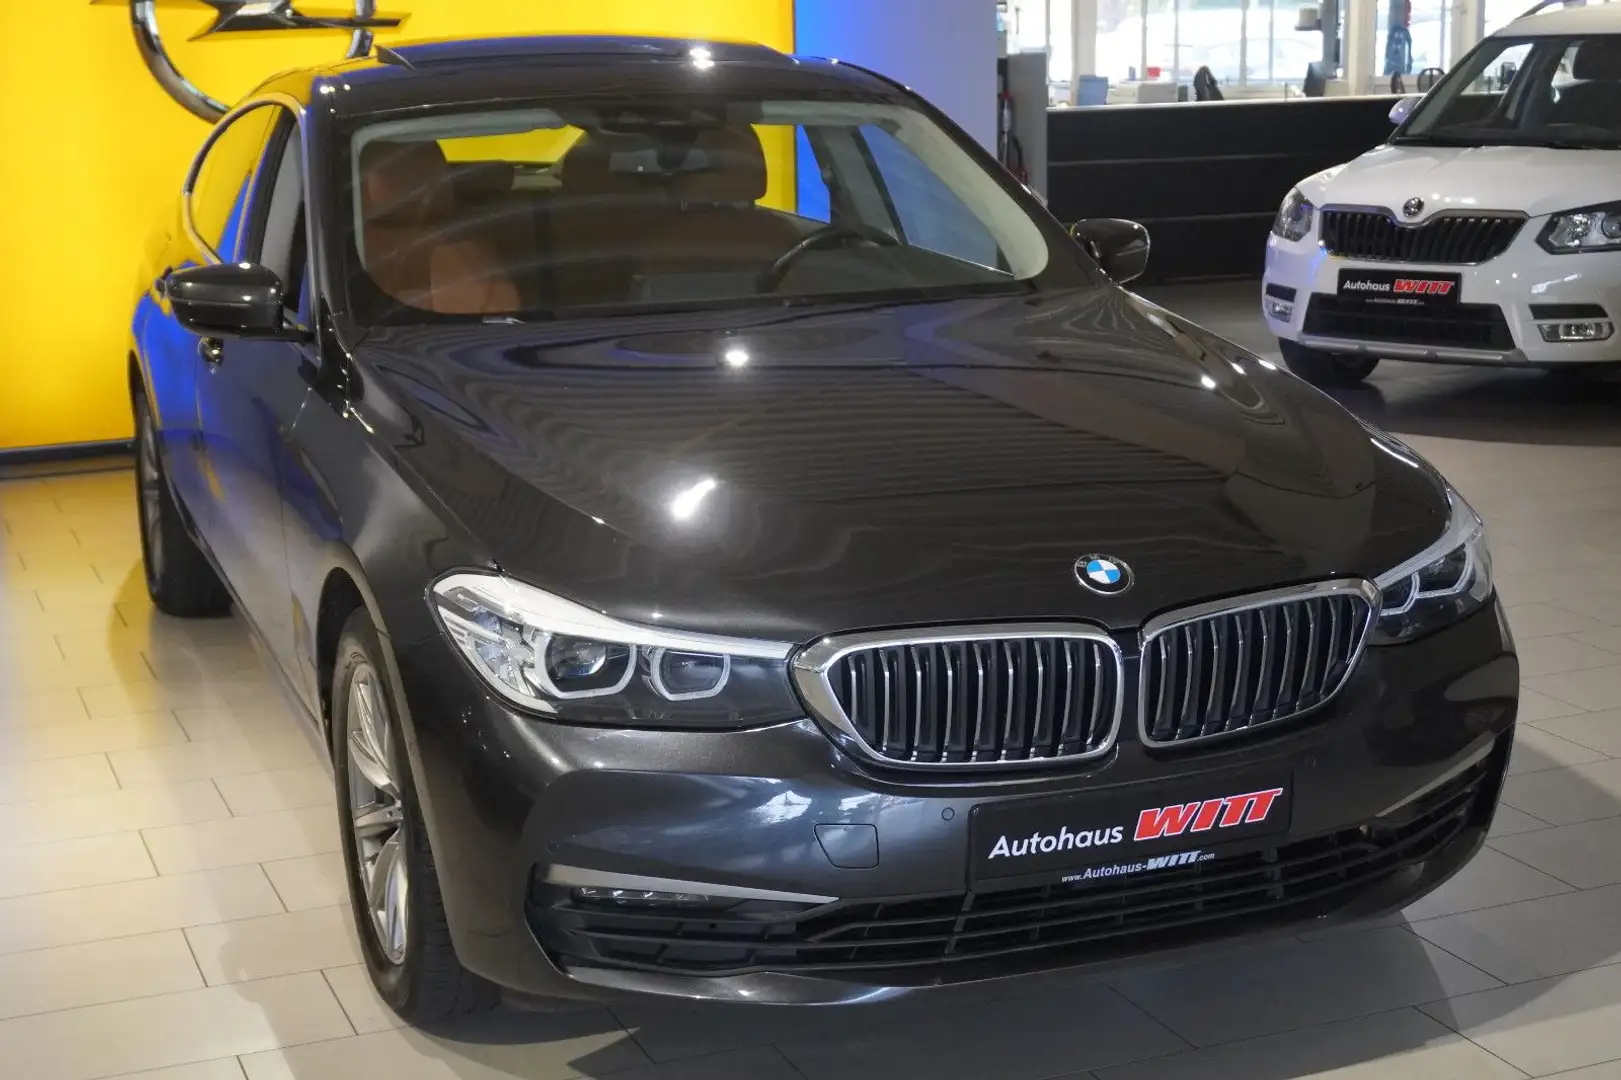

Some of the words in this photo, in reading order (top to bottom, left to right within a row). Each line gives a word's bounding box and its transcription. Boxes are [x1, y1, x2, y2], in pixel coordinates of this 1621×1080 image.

[1343, 280, 1390, 291] Autohaus
[1393, 279, 1454, 294] WITT
[988, 826, 1123, 859] Autohaus
[1134, 788, 1283, 841] WITT
[1061, 850, 1215, 883] www.Autohaus-WITT.com
